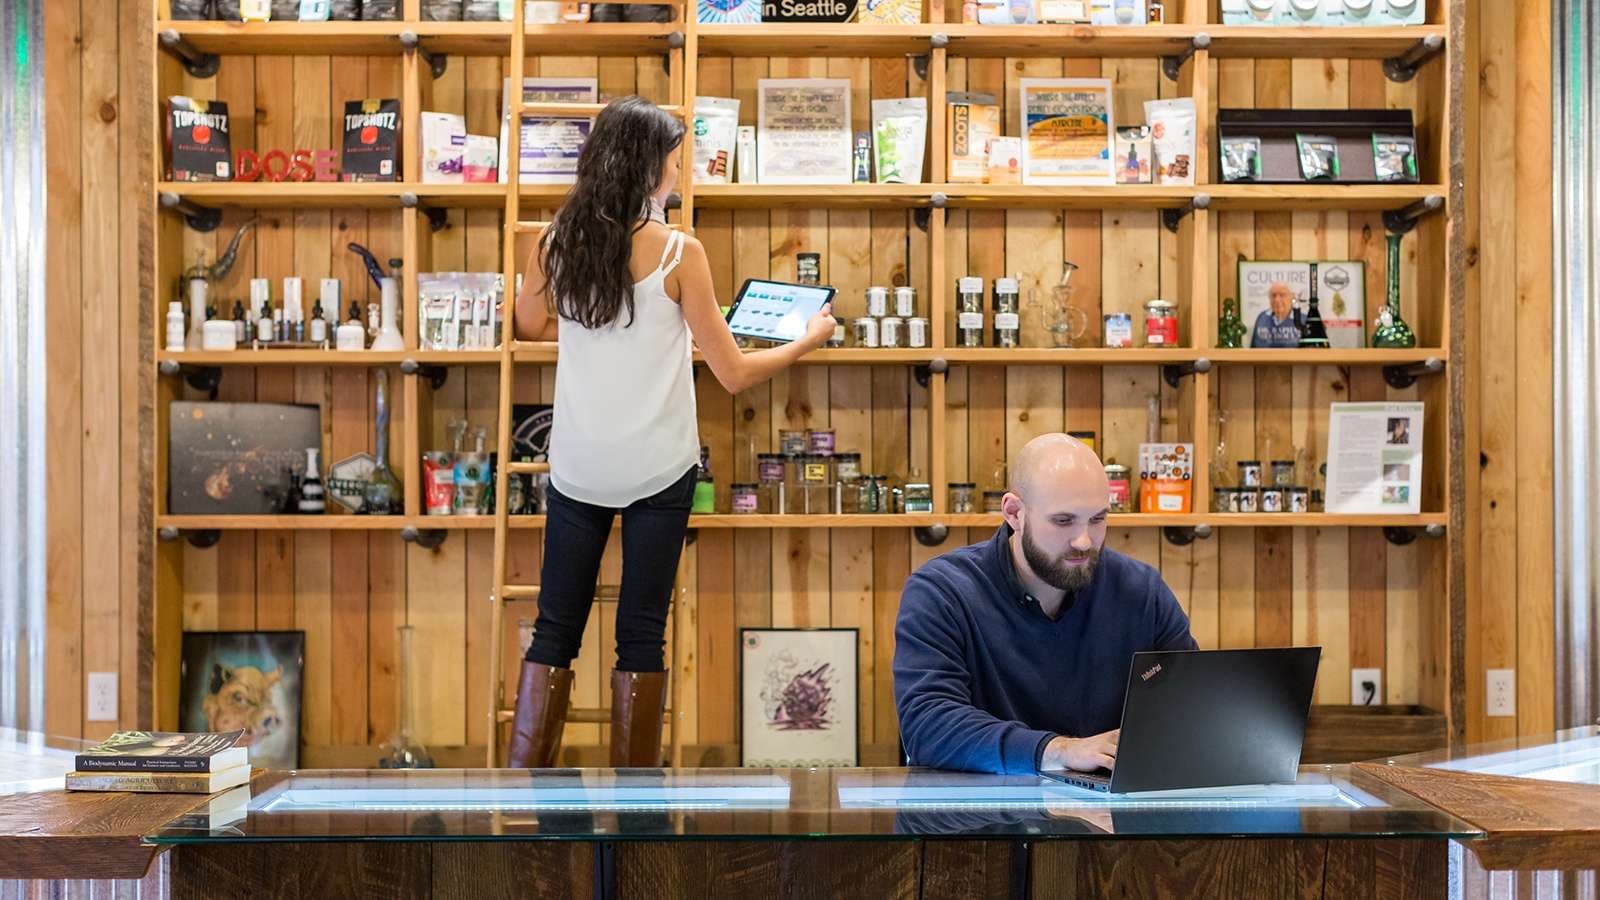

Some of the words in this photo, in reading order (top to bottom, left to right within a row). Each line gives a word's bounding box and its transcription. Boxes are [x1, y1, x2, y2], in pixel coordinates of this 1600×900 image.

[781, 0, 848, 17] Seattle
[173, 110, 228, 133] TOPSHOTZ
[345, 112, 396, 131] TOPSHOTZ
[955, 105, 968, 155] ZOOTS
[235, 149, 338, 182] DOSE
[1248, 271, 1307, 285] CULTURE
